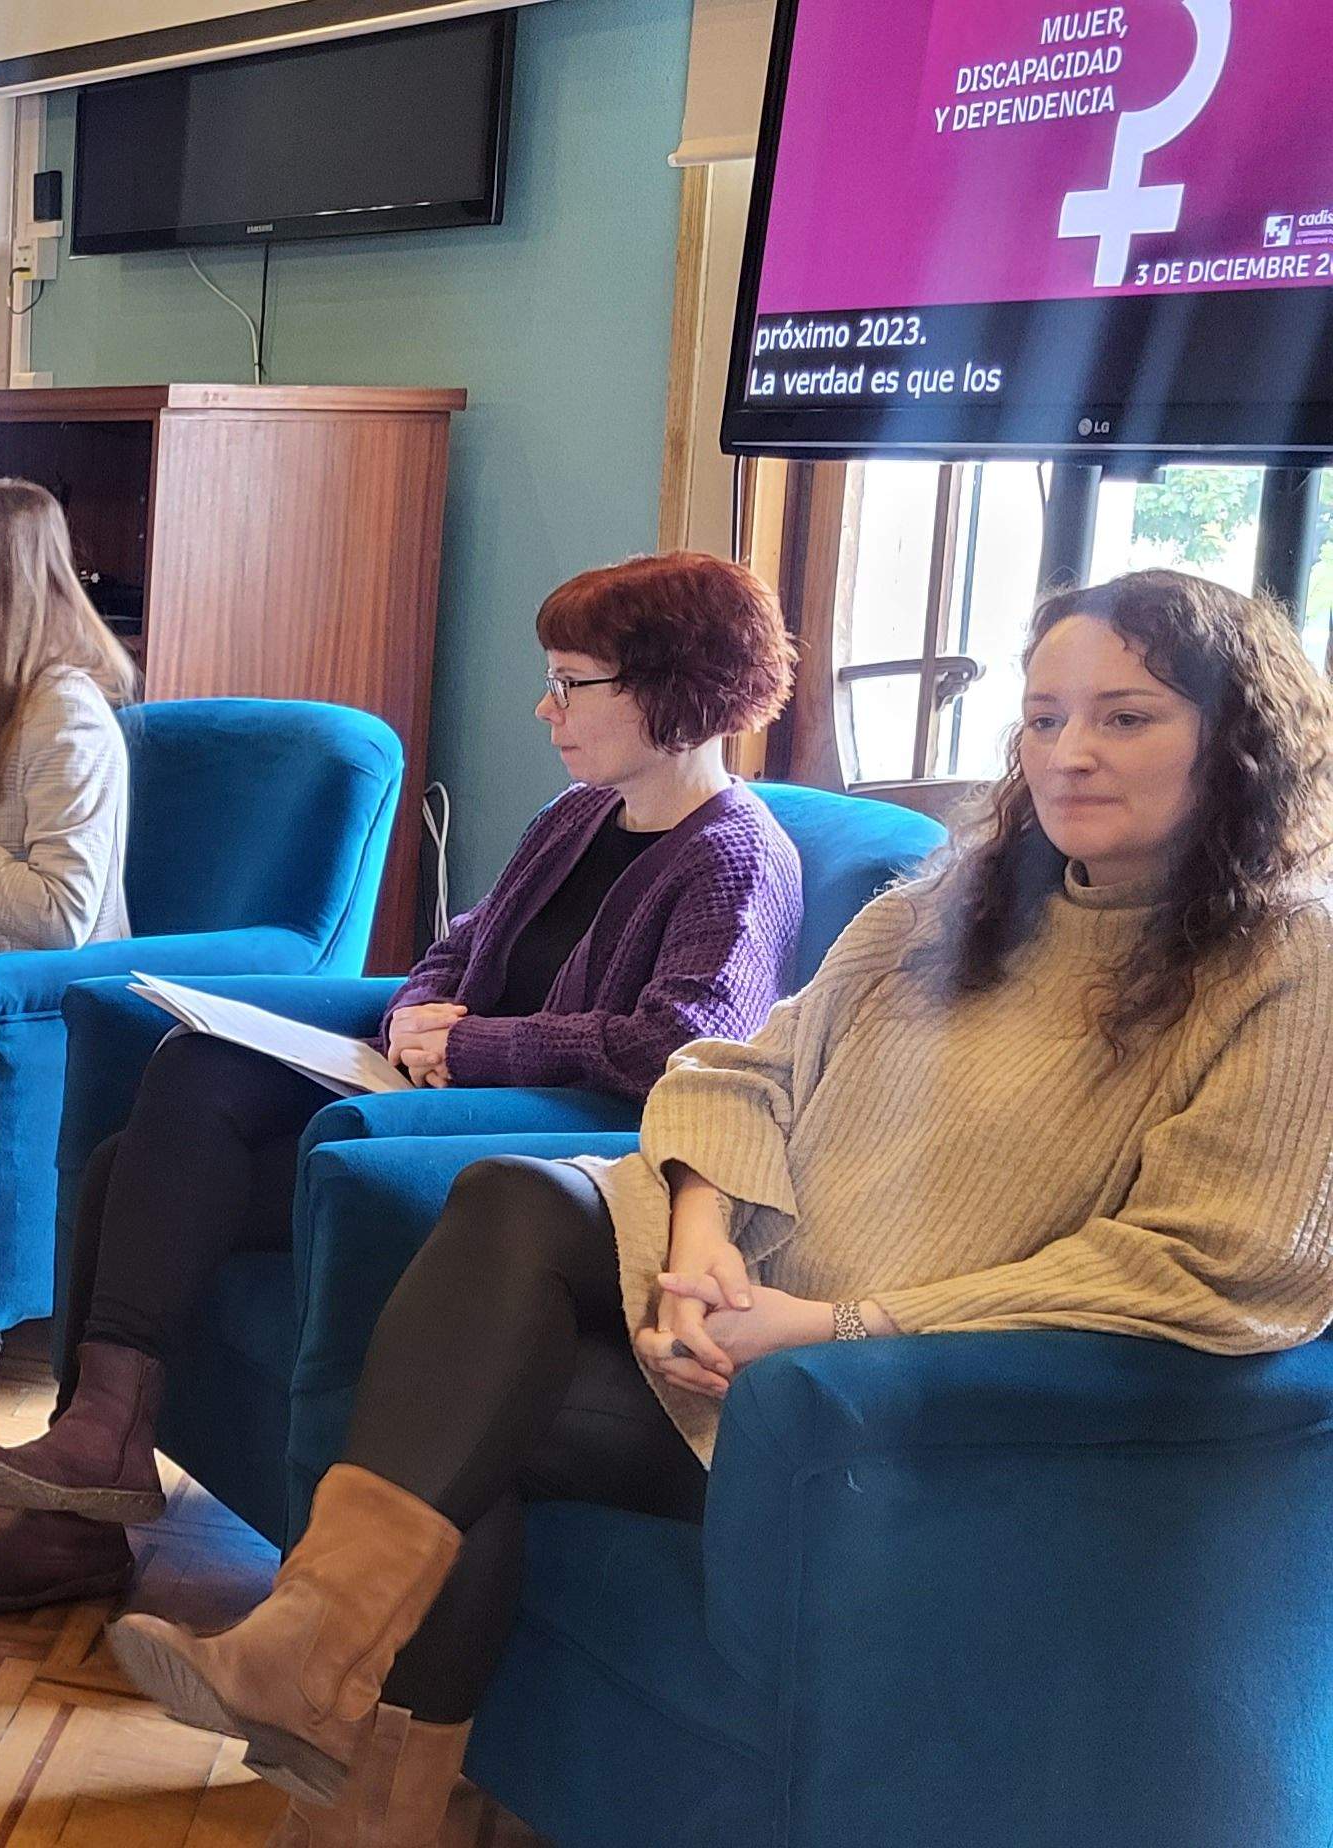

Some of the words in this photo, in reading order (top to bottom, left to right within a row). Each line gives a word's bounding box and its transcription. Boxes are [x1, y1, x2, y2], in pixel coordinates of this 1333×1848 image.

[1040, 6, 1129, 45] MUJER,
[956, 45, 1123, 95] DISCAPACIDAD
[934, 106, 951, 134] Y
[952, 84, 1116, 132] DEPENDENCIA
[1134, 263, 1150, 287] 3
[1153, 262, 1184, 286] DE
[1187, 254, 1313, 284] DICIEMBRE
[1315, 252, 1333, 277] 2
[754, 318, 850, 357] próximo
[856, 316, 927, 347] 2023.
[749, 367, 776, 396] La
[784, 363, 865, 396] verdad
[870, 368, 899, 394] es
[907, 367, 955, 400] que
[962, 361, 1001, 393] los
[1094, 421, 1110, 434] LG
